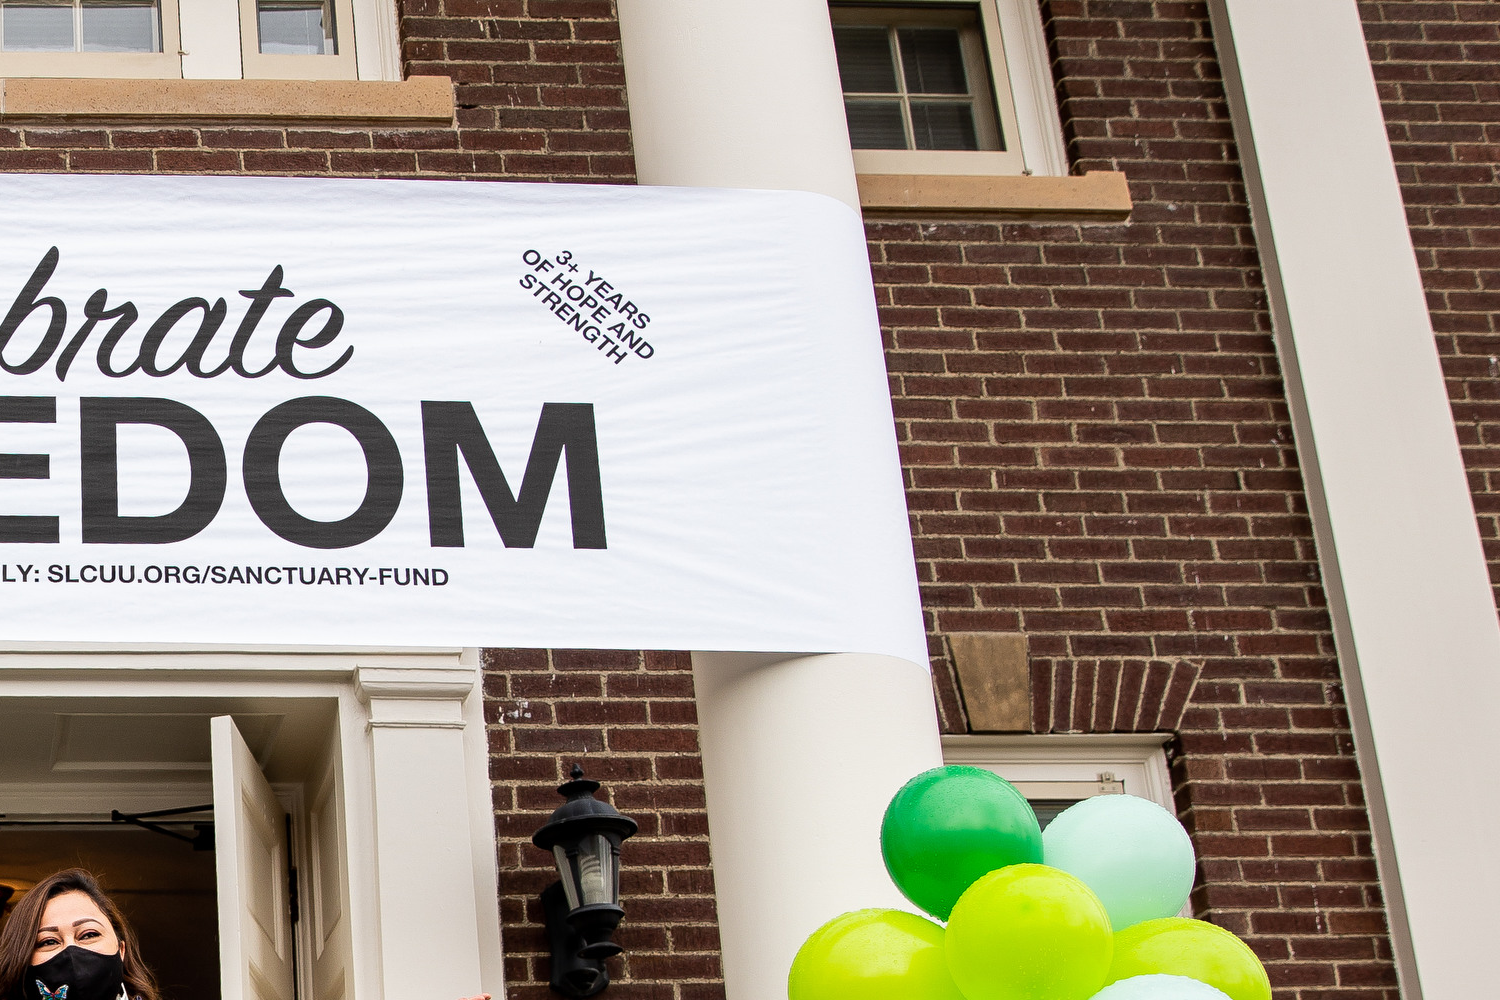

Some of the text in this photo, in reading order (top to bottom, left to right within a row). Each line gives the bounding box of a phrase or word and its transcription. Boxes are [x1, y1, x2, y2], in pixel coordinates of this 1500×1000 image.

[519, 273, 628, 365] STRENGTH
[522, 249, 655, 360] OF HOPE AND
[555, 250, 651, 330] 3+ YEARS
[47, 564, 449, 586] SLCUU.ORG/SANCTUARY-FUND
